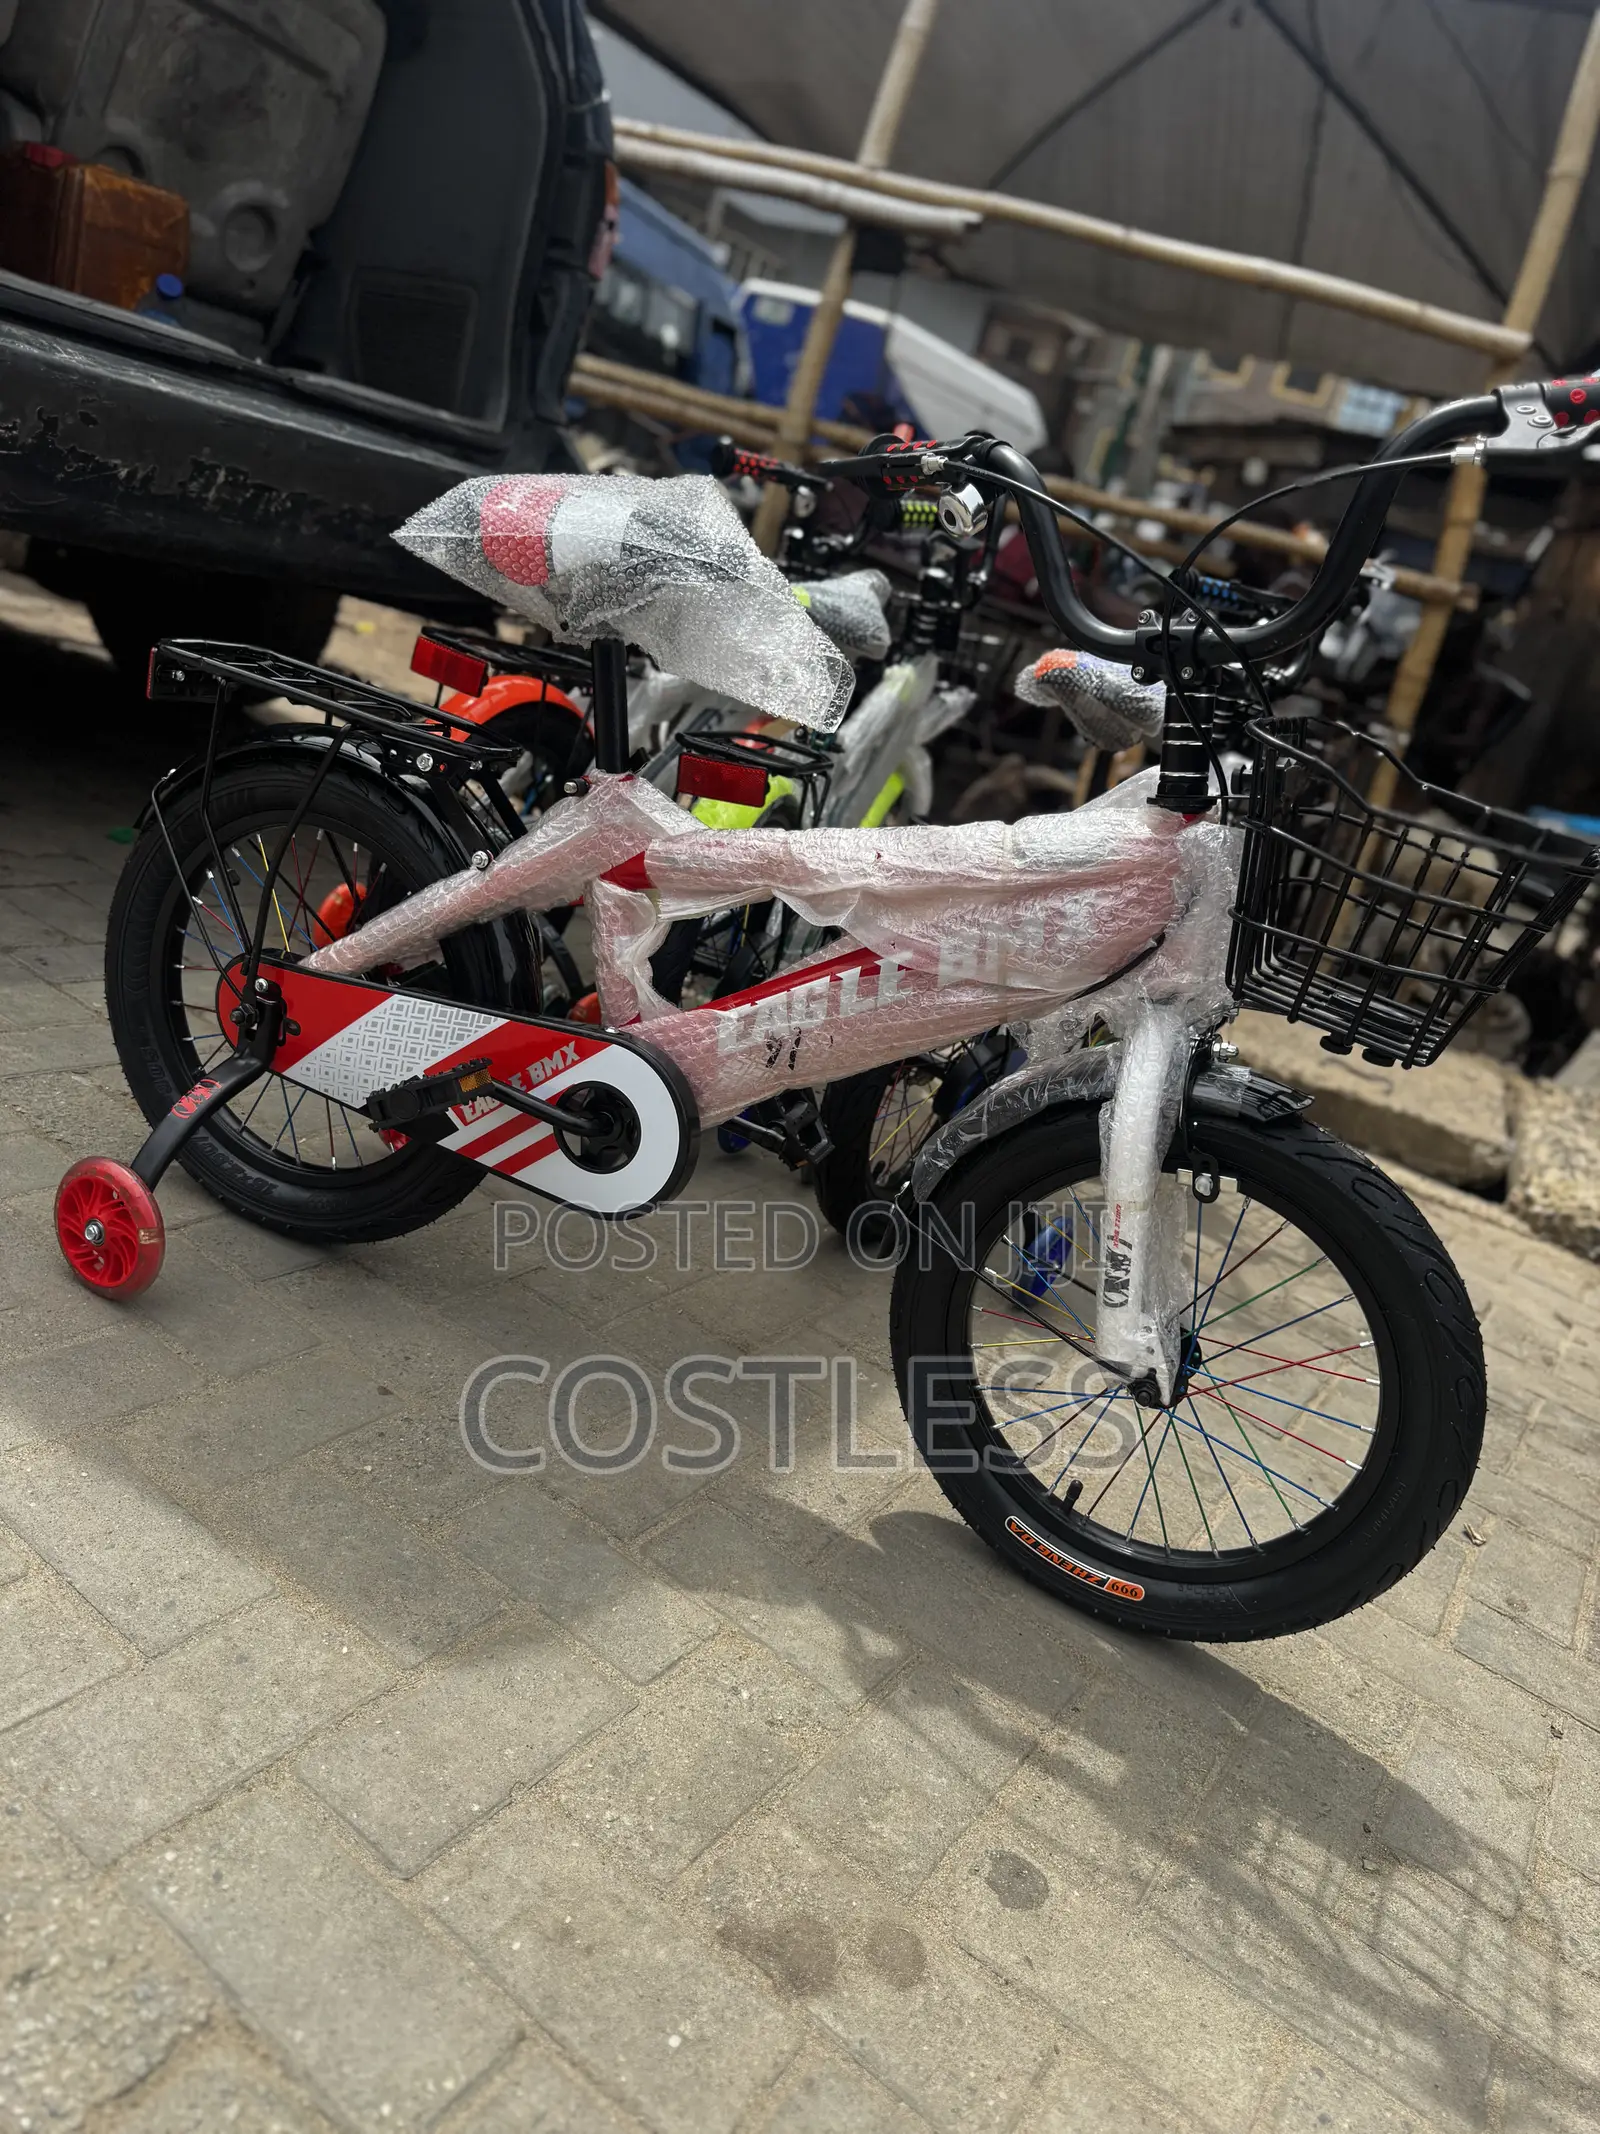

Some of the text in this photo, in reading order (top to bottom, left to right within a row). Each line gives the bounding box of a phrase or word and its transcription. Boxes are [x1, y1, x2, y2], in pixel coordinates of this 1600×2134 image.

[715, 951, 913, 1057] EAGLE
[526, 1040, 580, 1086] BMX
[1009, 1520, 1034, 1546] DA
[1035, 1544, 1102, 1585] ZHENG
